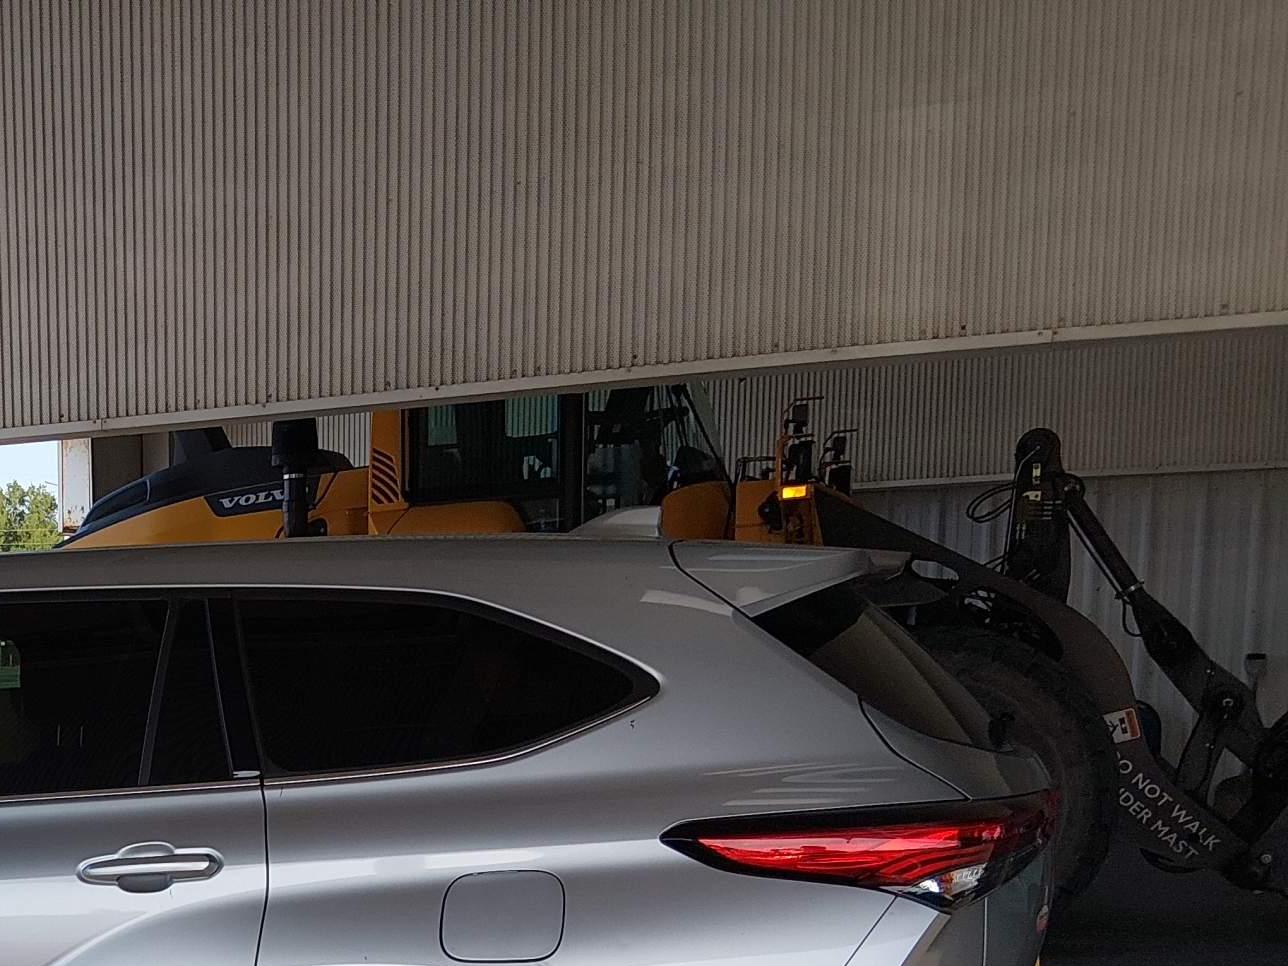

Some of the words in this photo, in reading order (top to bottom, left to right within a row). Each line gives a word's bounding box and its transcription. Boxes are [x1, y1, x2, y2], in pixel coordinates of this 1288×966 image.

[218, 488, 286, 509] VOLV
[1116, 751, 1133, 774] O
[1132, 772, 1174, 806] NOT
[1170, 803, 1223, 851] WALK
[1119, 787, 1153, 825] DER
[1150, 819, 1200, 860] MAST
